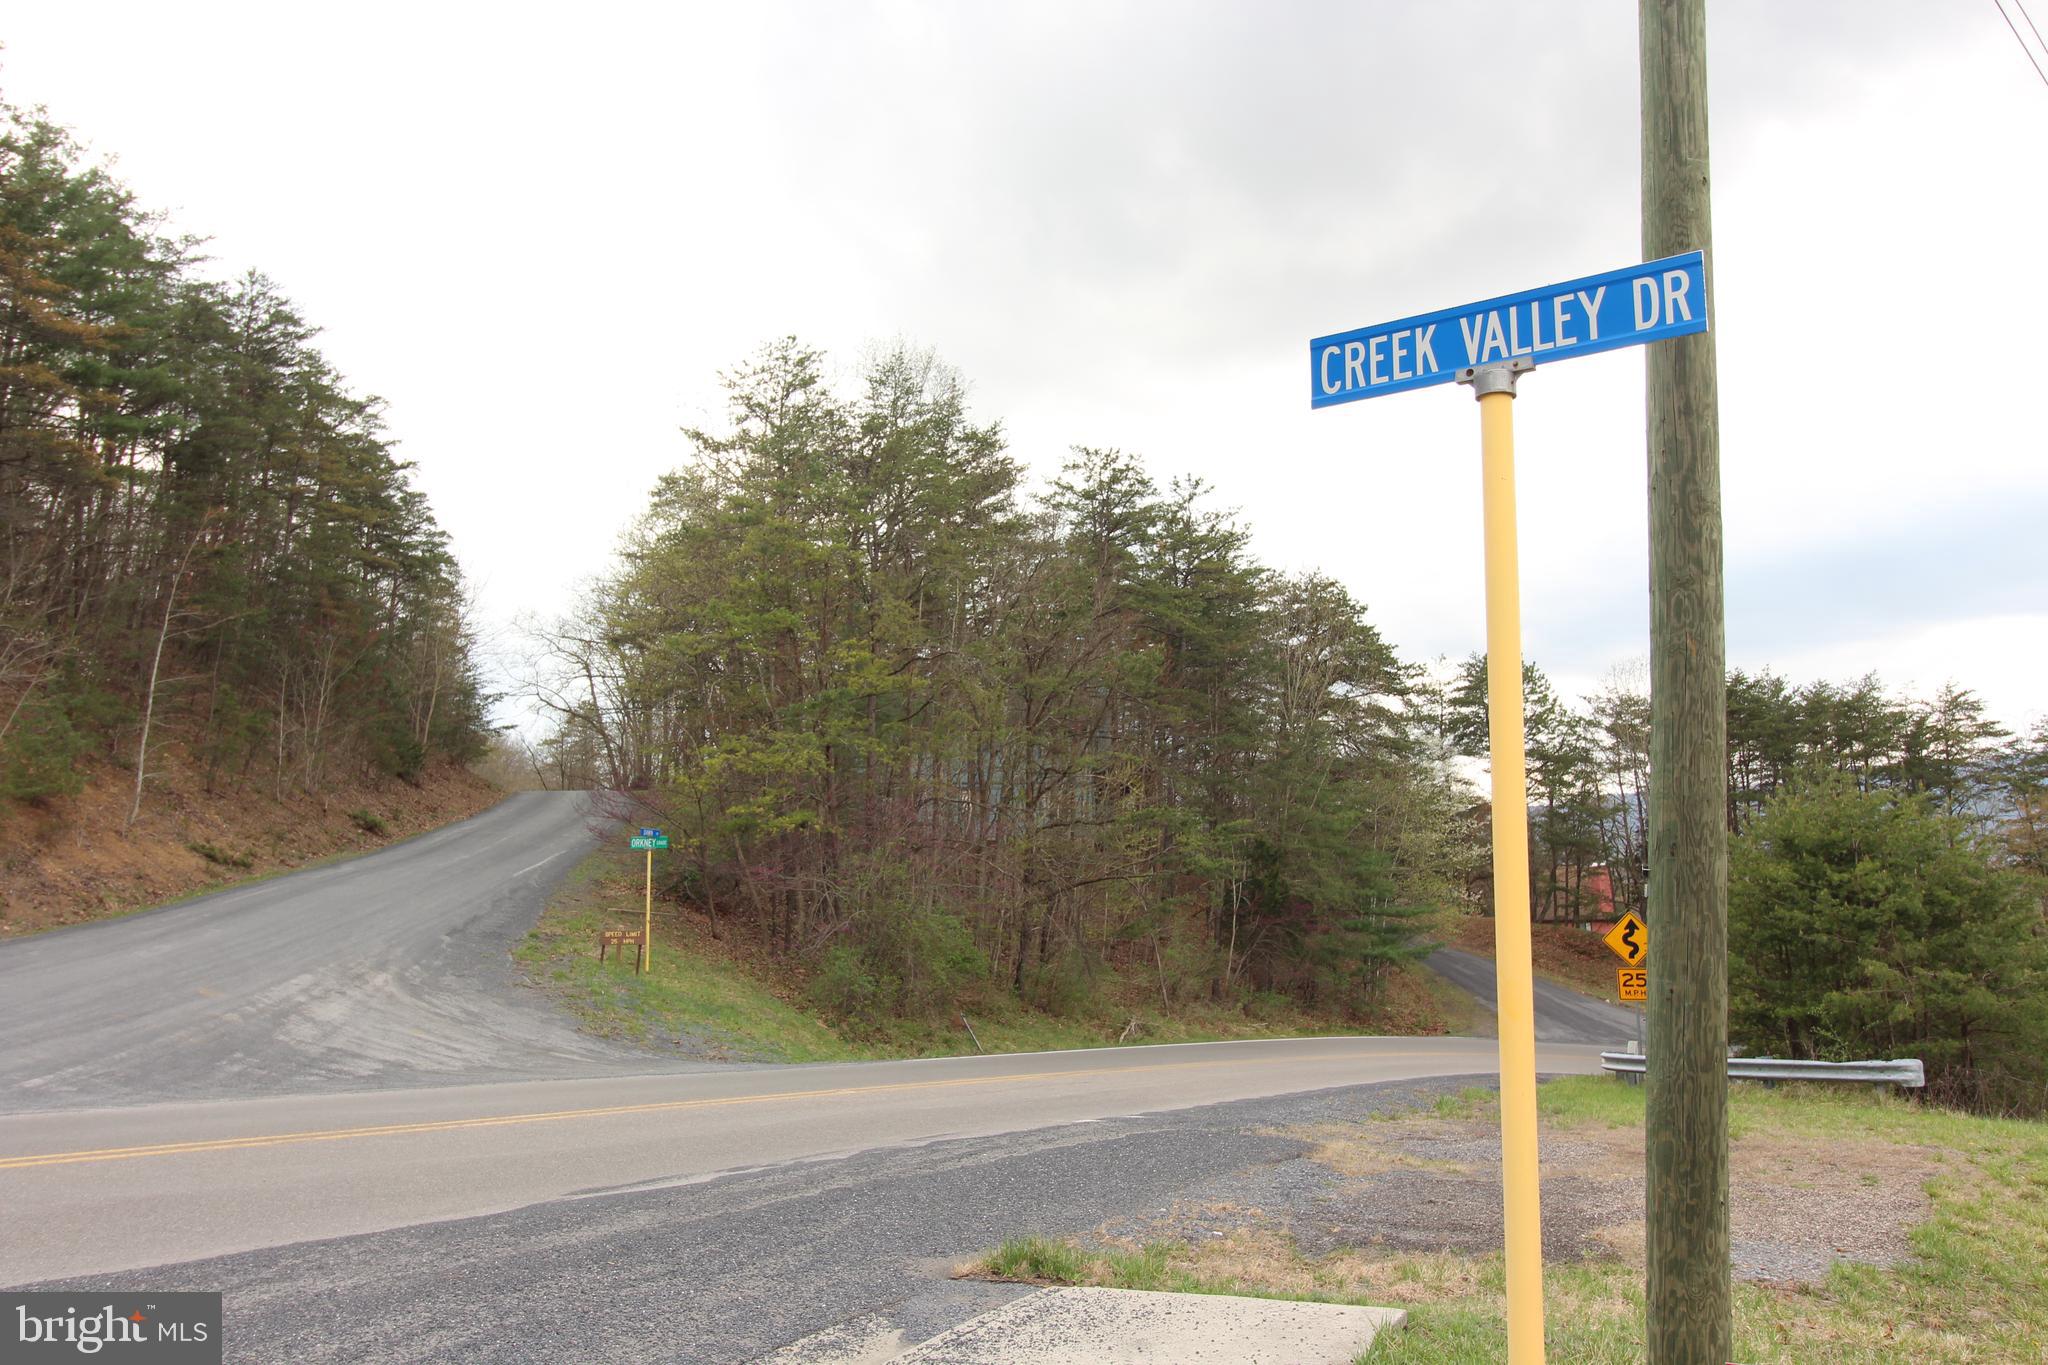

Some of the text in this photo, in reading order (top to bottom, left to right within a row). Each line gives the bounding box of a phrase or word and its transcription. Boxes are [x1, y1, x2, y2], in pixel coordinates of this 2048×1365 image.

[1321, 269, 1692, 394] CREEK VALLEY DR
[631, 839, 656, 848] ORKNEY
[1622, 973, 1647, 987] 25
